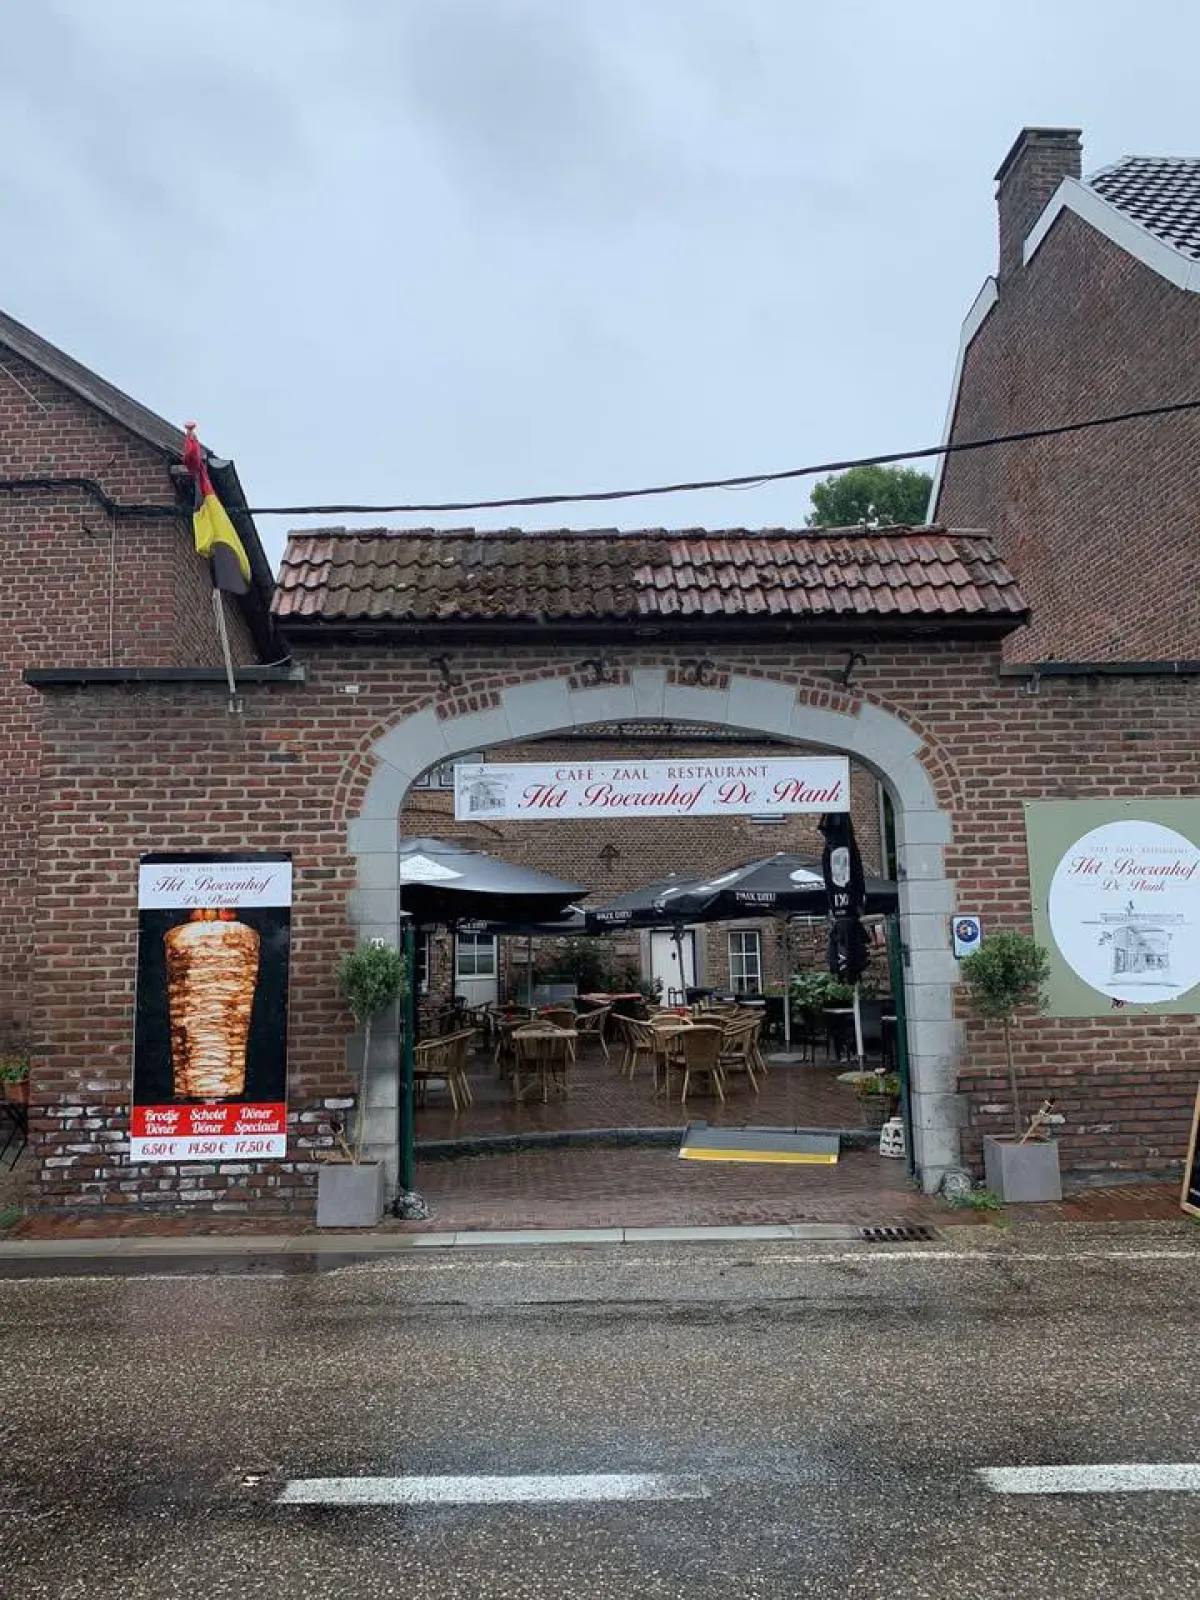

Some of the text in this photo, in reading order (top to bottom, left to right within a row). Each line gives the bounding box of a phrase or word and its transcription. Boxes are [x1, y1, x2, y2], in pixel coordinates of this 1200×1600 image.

[612, 768, 650, 781] ZAAL
[667, 765, 769, 779] RESTAURANT
[517, 778, 843, 813] Het Boerenhof De Plank
[1068, 857, 1200, 880] Het Boerenhof
[190, 874, 276, 894] Boerenhof
